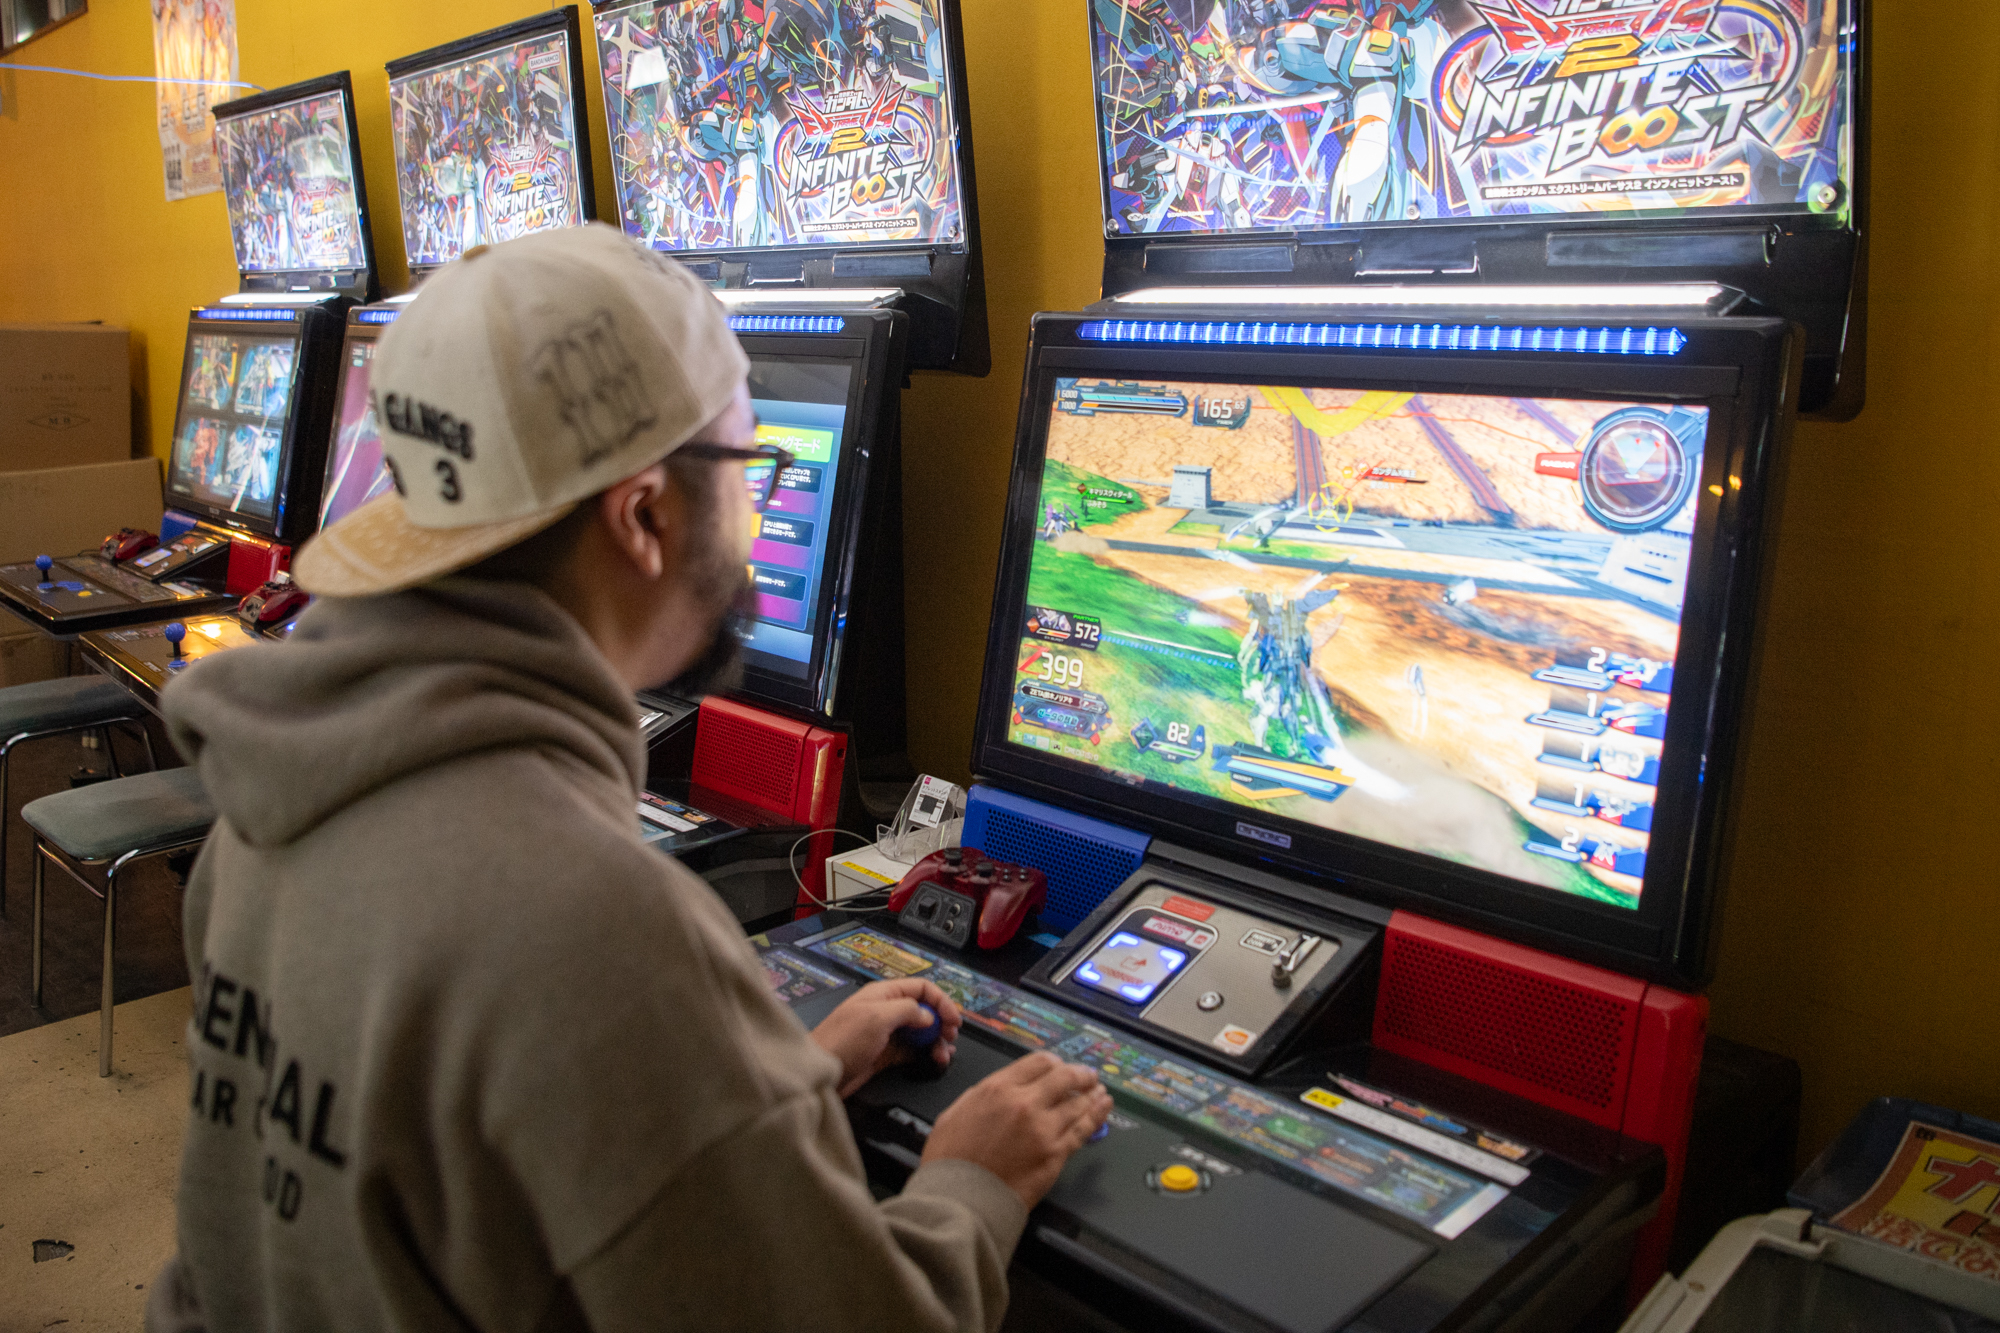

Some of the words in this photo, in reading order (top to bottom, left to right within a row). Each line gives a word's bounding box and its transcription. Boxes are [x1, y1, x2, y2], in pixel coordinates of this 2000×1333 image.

[1554, 35, 1642, 78] 2
[1453, 58, 1697, 154] INFINITE
[828, 127, 867, 154] 2
[512, 172, 533, 192] 2
[788, 144, 890, 200] INFINITE
[492, 184, 545, 226] INFINITE
[1060, 401, 1077, 410] 1000
[1061, 389, 1079, 399] 6000
[1074, 622, 1101, 642] 572
[1037, 651, 1084, 688] 399
[1587, 646, 1607, 673] 2
[1586, 692, 1598, 718] 1
[1167, 721, 1190, 745] 82
[1580, 738, 1590, 763] 1
[1573, 782, 1584, 808] 1
[1561, 825, 1580, 853] 2
